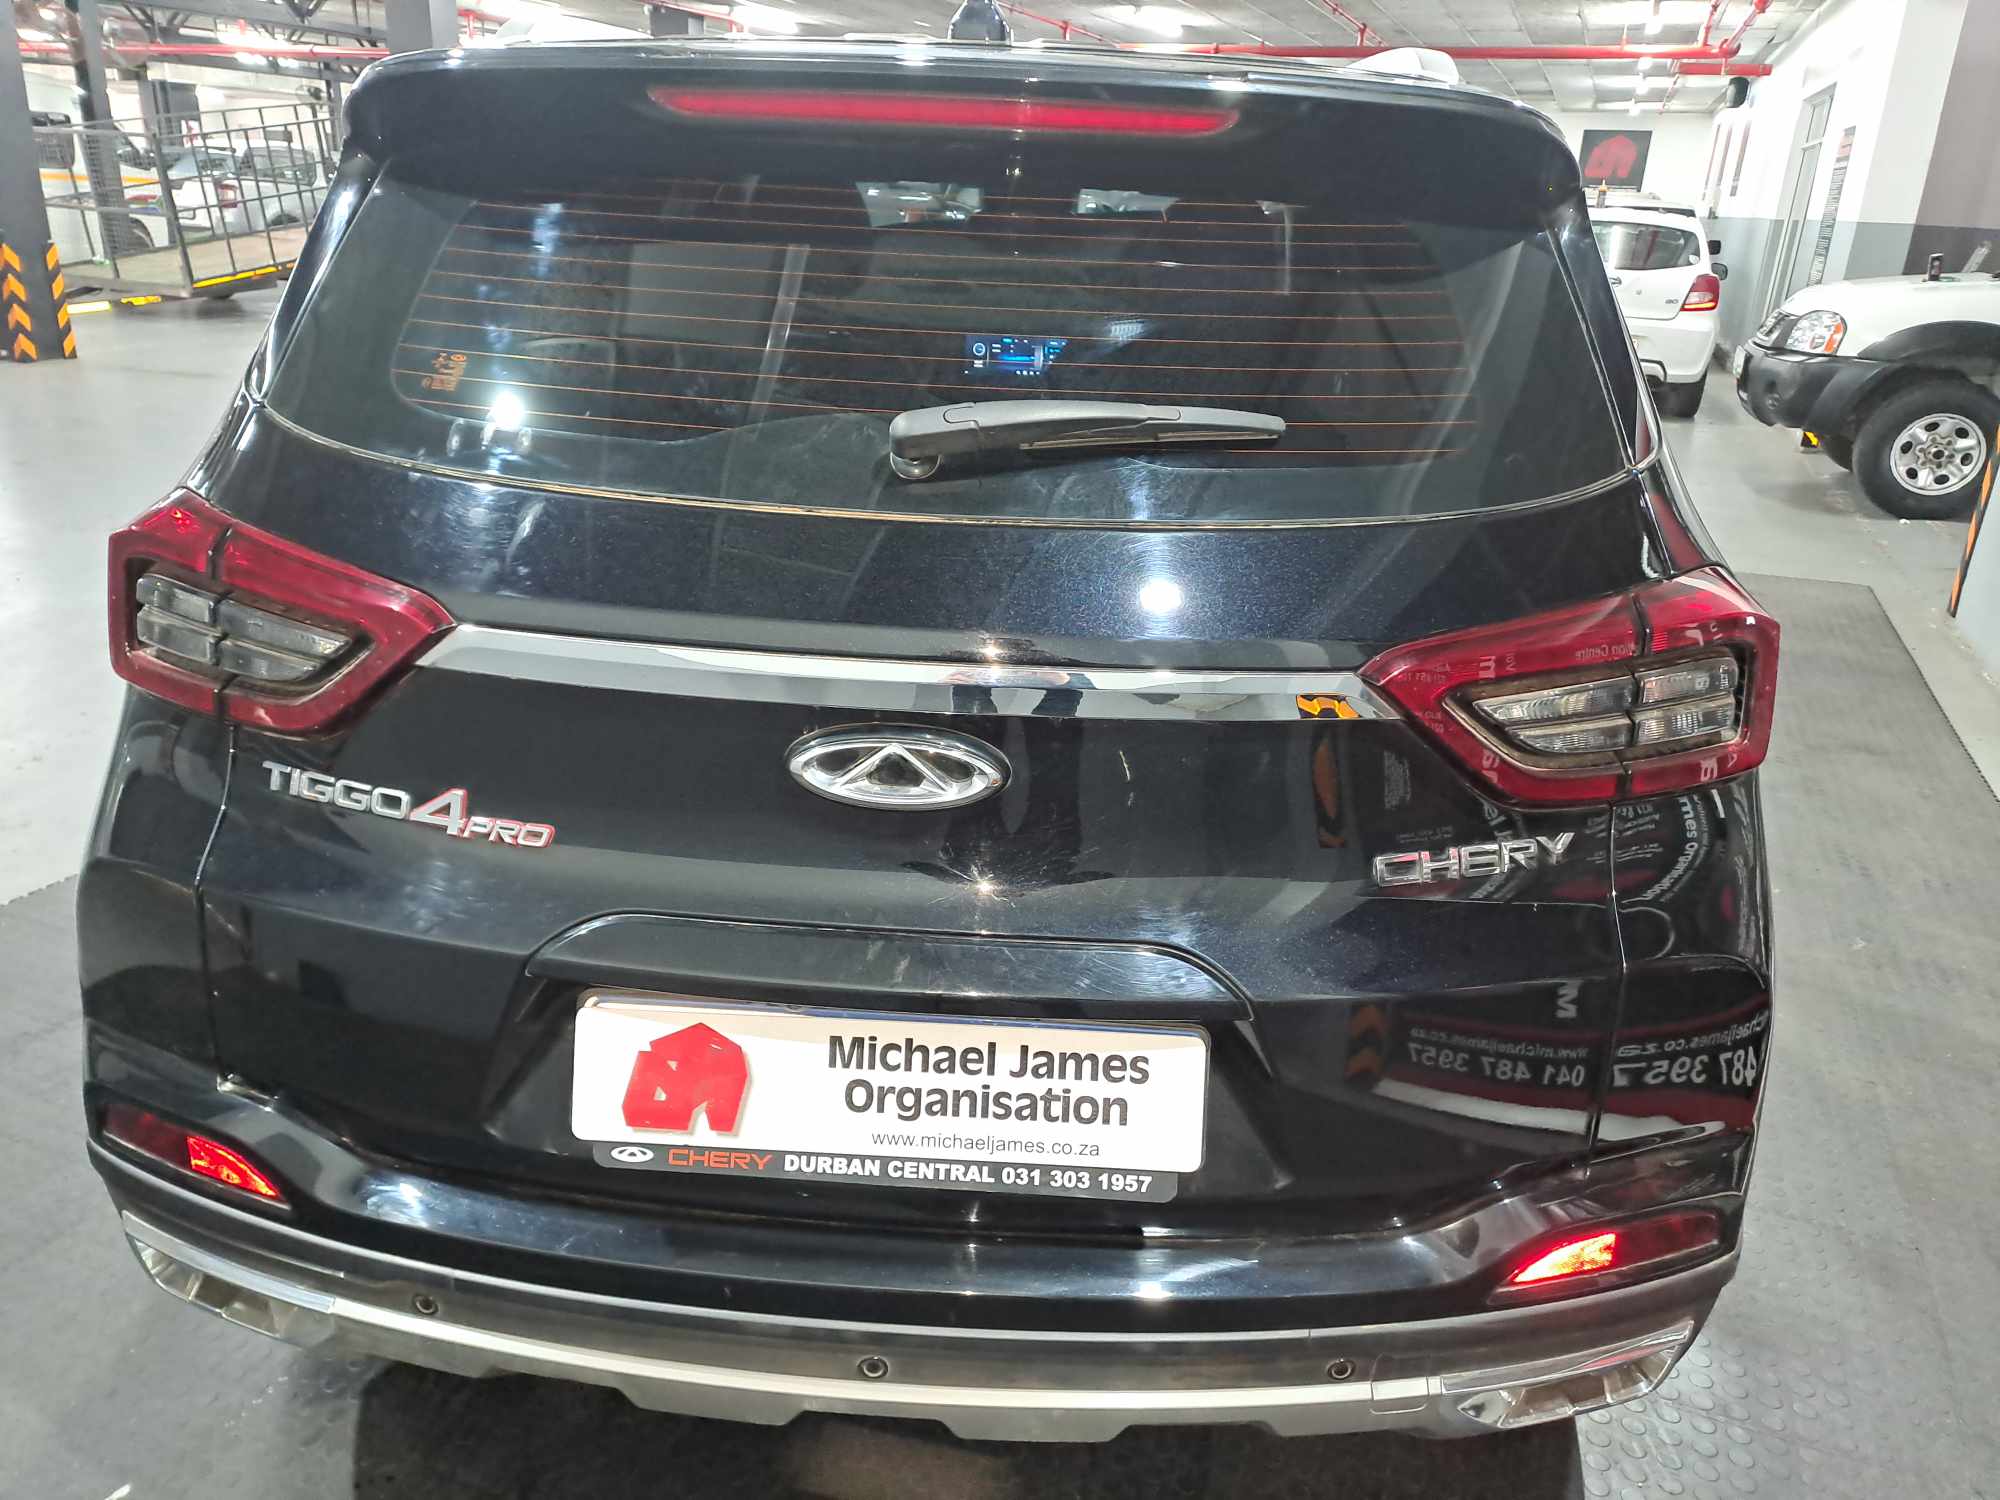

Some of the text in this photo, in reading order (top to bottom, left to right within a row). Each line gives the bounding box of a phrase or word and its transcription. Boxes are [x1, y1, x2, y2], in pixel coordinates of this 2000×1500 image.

[262, 760, 557, 848] TIGGO 4 PRO
[1372, 831, 1575, 887] CHERY
[828, 1034, 1150, 1086] Michael James
[844, 1077, 1129, 1127] Organisation
[872, 1130, 1100, 1158] www.michaeljames.co.za
[667, 1149, 1152, 1193] CHERY DURBAN CENTRAL 031 303 1957
